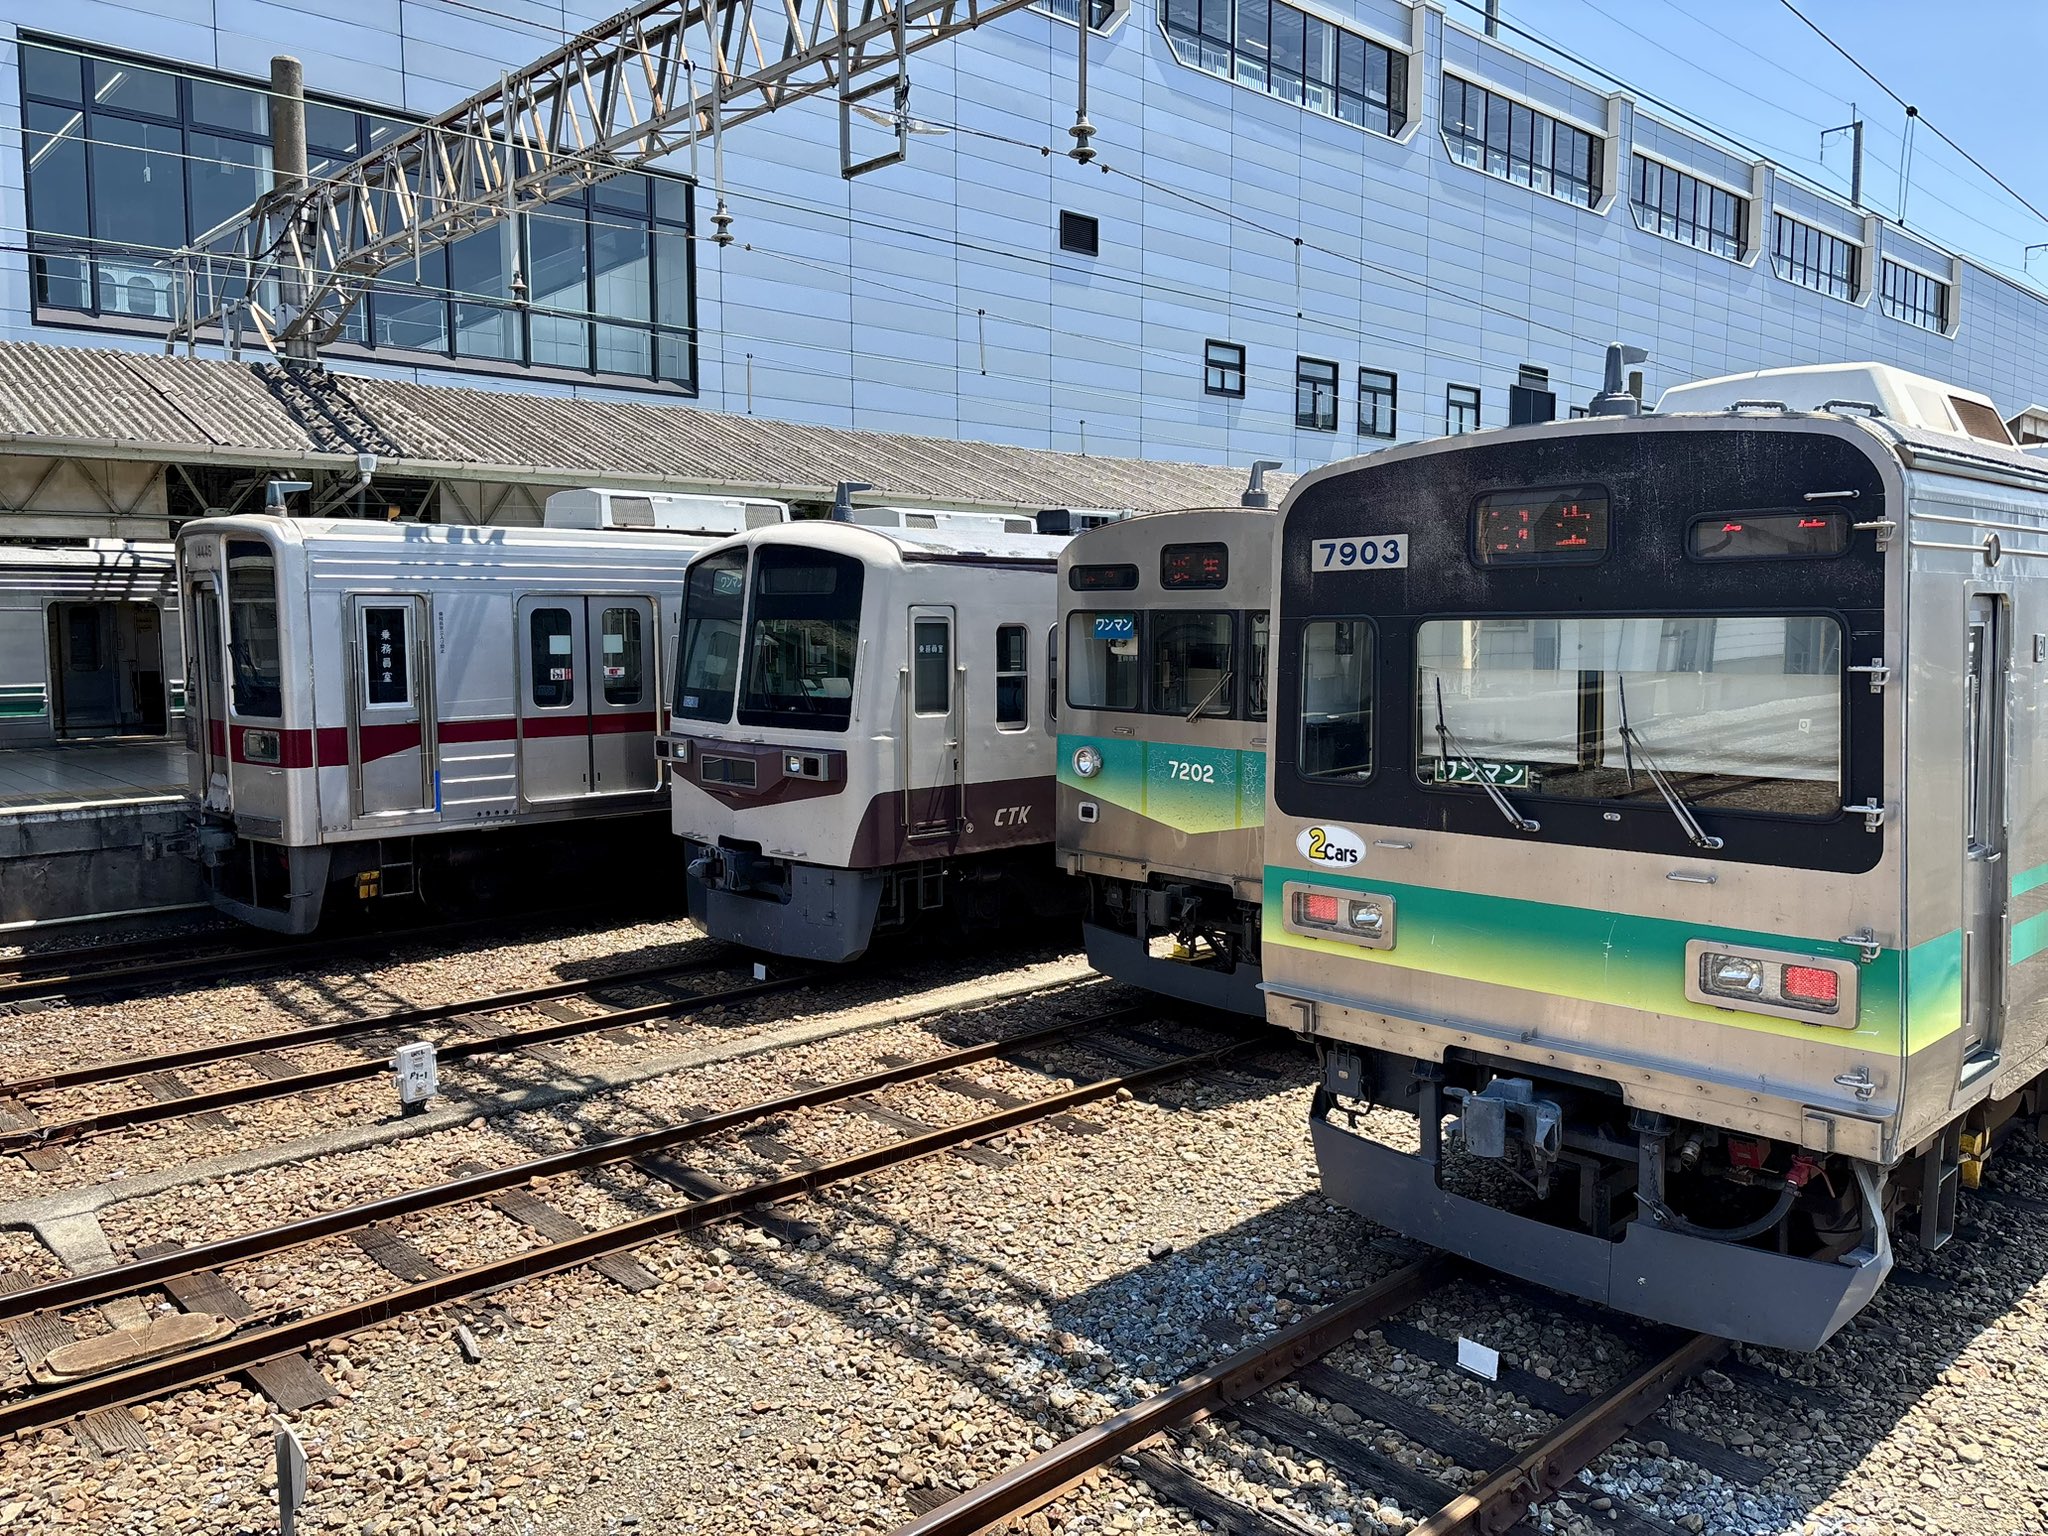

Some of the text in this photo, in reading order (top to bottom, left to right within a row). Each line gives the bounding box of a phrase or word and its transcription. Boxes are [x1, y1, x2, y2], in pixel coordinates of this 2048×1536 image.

[1319, 540, 1400, 567] 7903
[1095, 618, 1133, 631] ワンマン
[380, 629, 393, 683] 乗務員室
[1168, 760, 1215, 784] 7202
[1440, 761, 1524, 784] ワンマン
[994, 805, 1032, 827] CTK
